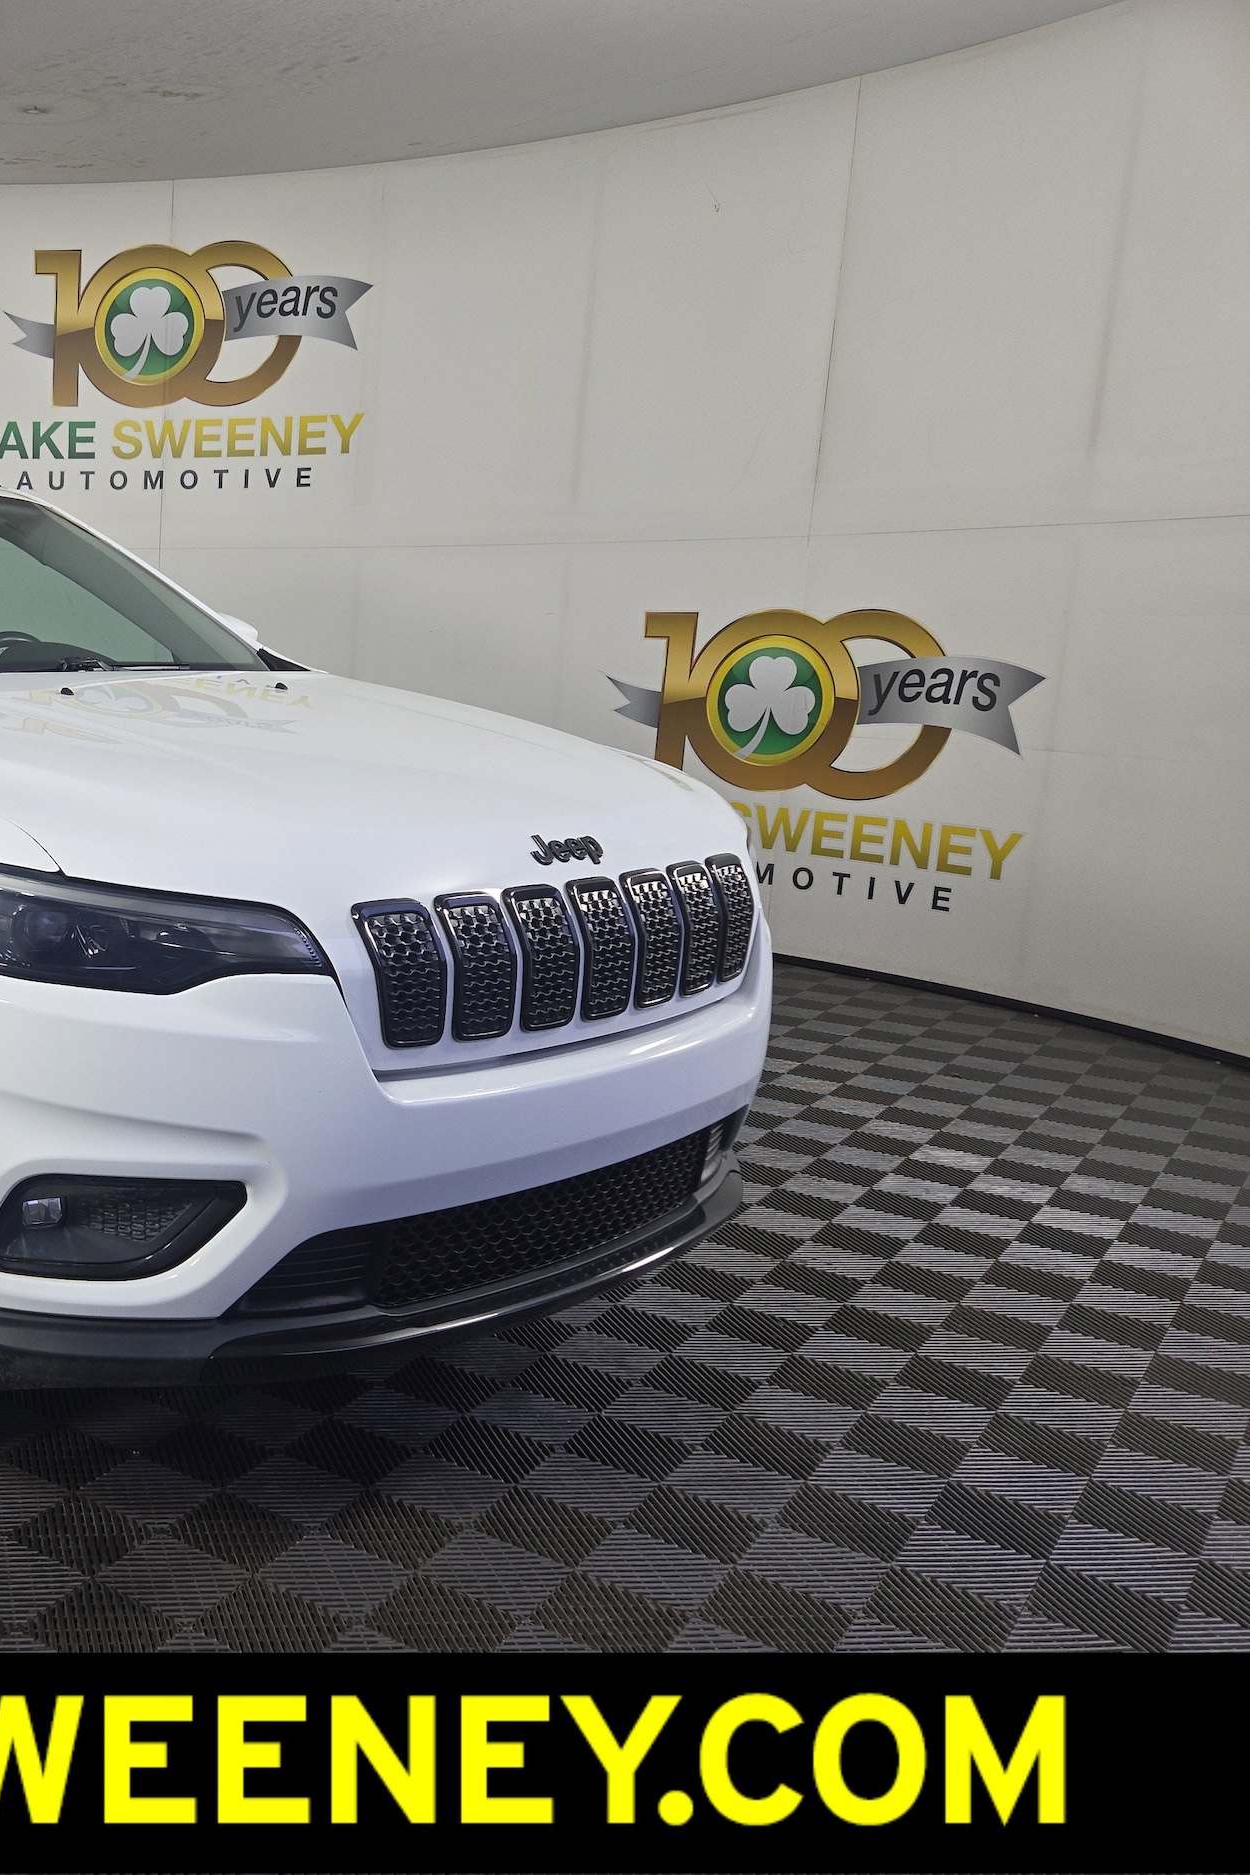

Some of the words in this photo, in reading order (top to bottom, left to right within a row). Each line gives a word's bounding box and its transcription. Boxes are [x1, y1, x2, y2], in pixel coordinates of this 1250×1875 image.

[34, 240, 302, 408] 100
[233, 284, 338, 333] years
[112, 413, 365, 460] SWEENEY
[16, 467, 312, 490] AUTOMOTIVE
[867, 668, 1001, 716] years
[530, 834, 604, 866] Jeep
[756, 862, 952, 912] MOTIVE
